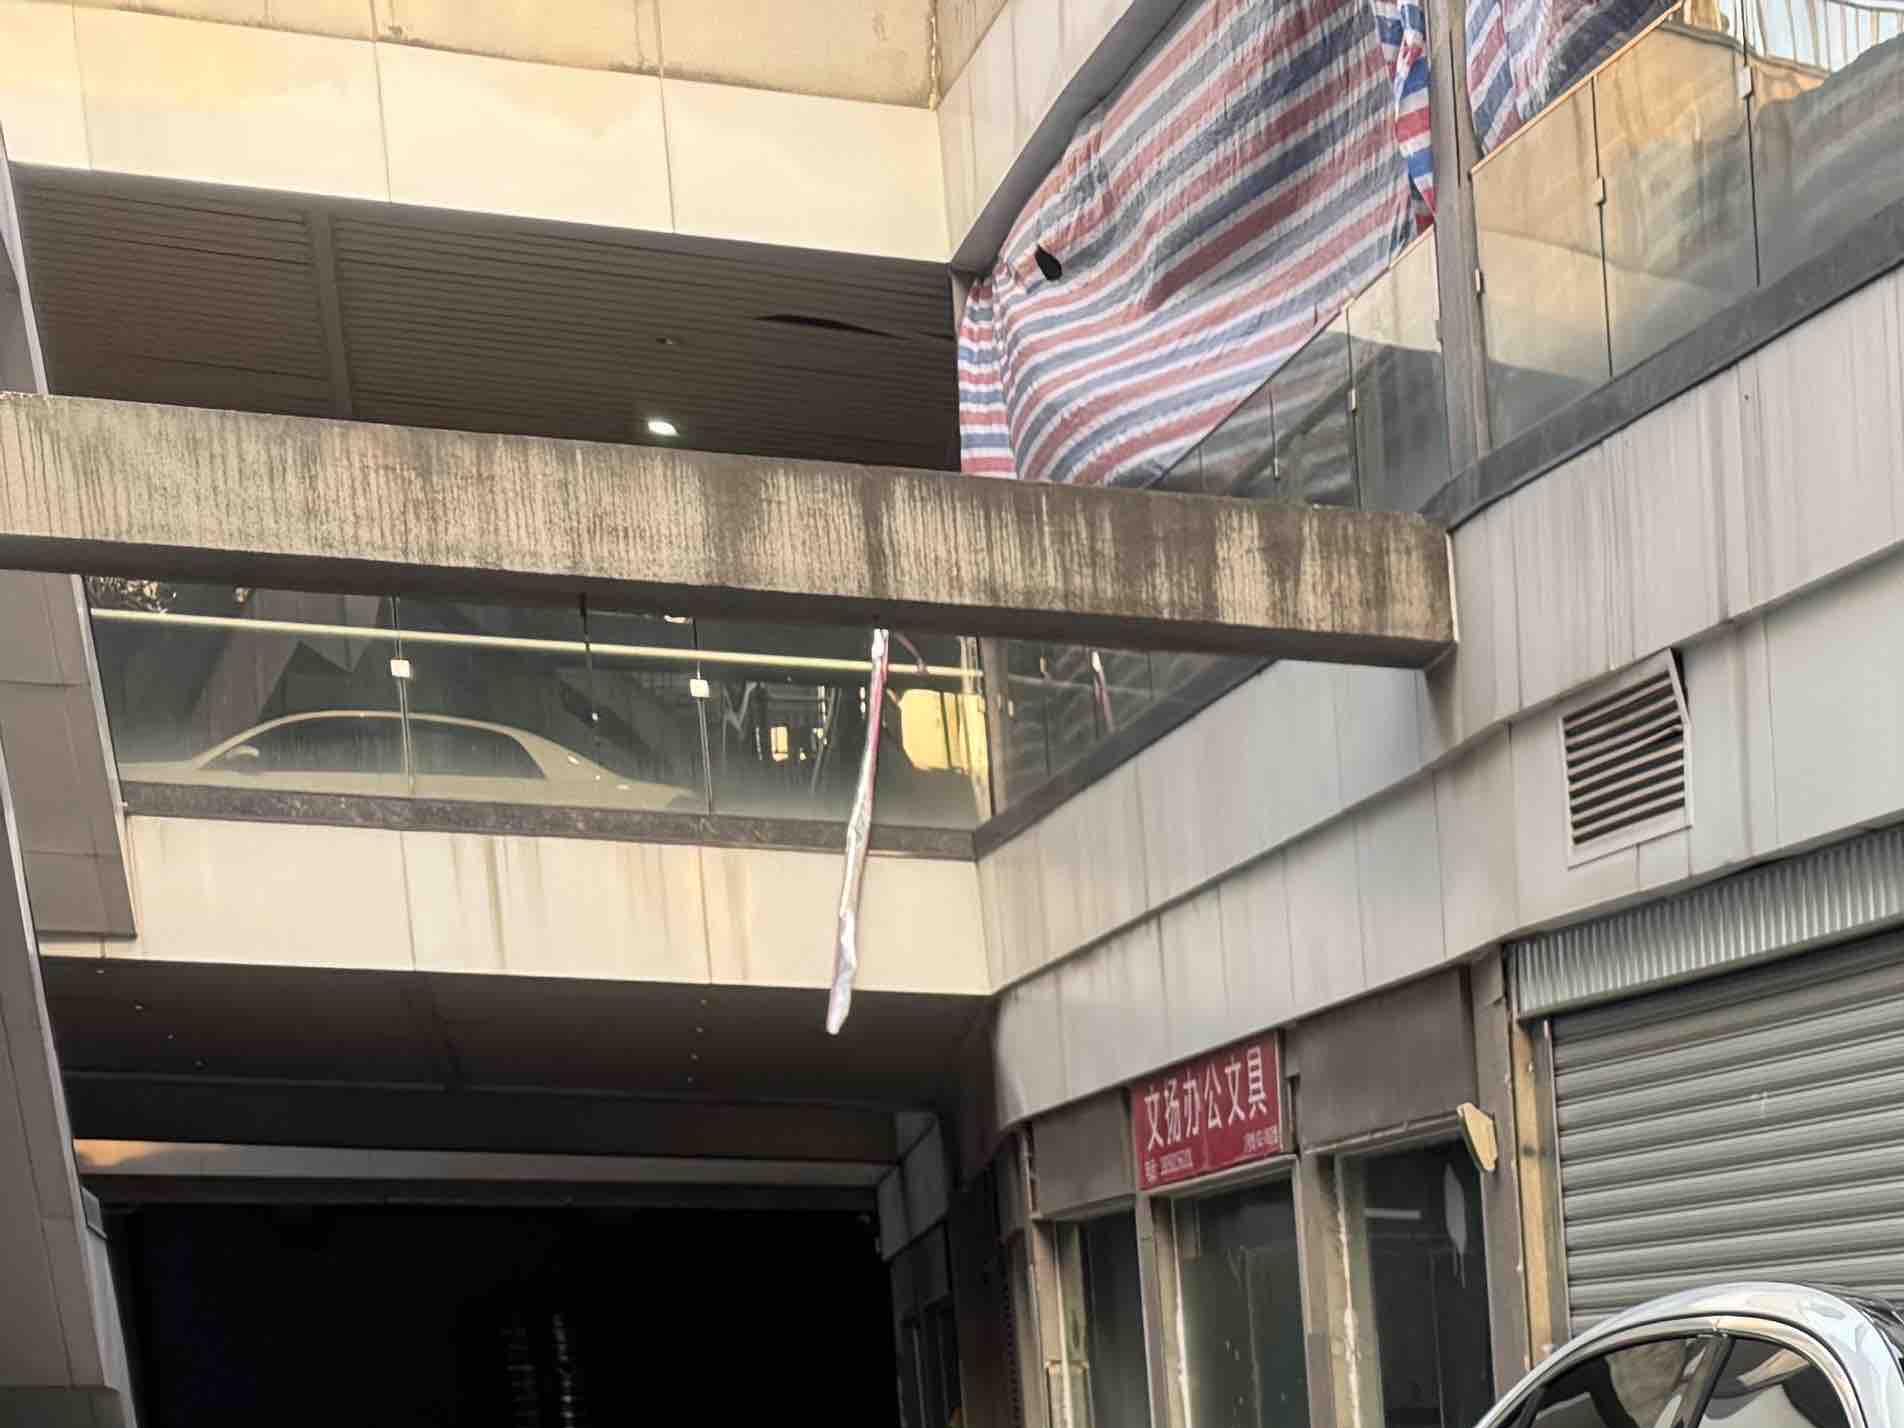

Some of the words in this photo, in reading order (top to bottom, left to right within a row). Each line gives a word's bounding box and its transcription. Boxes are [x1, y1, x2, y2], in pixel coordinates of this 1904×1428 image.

[1144, 1046, 1267, 1151] 文扬办公文具
